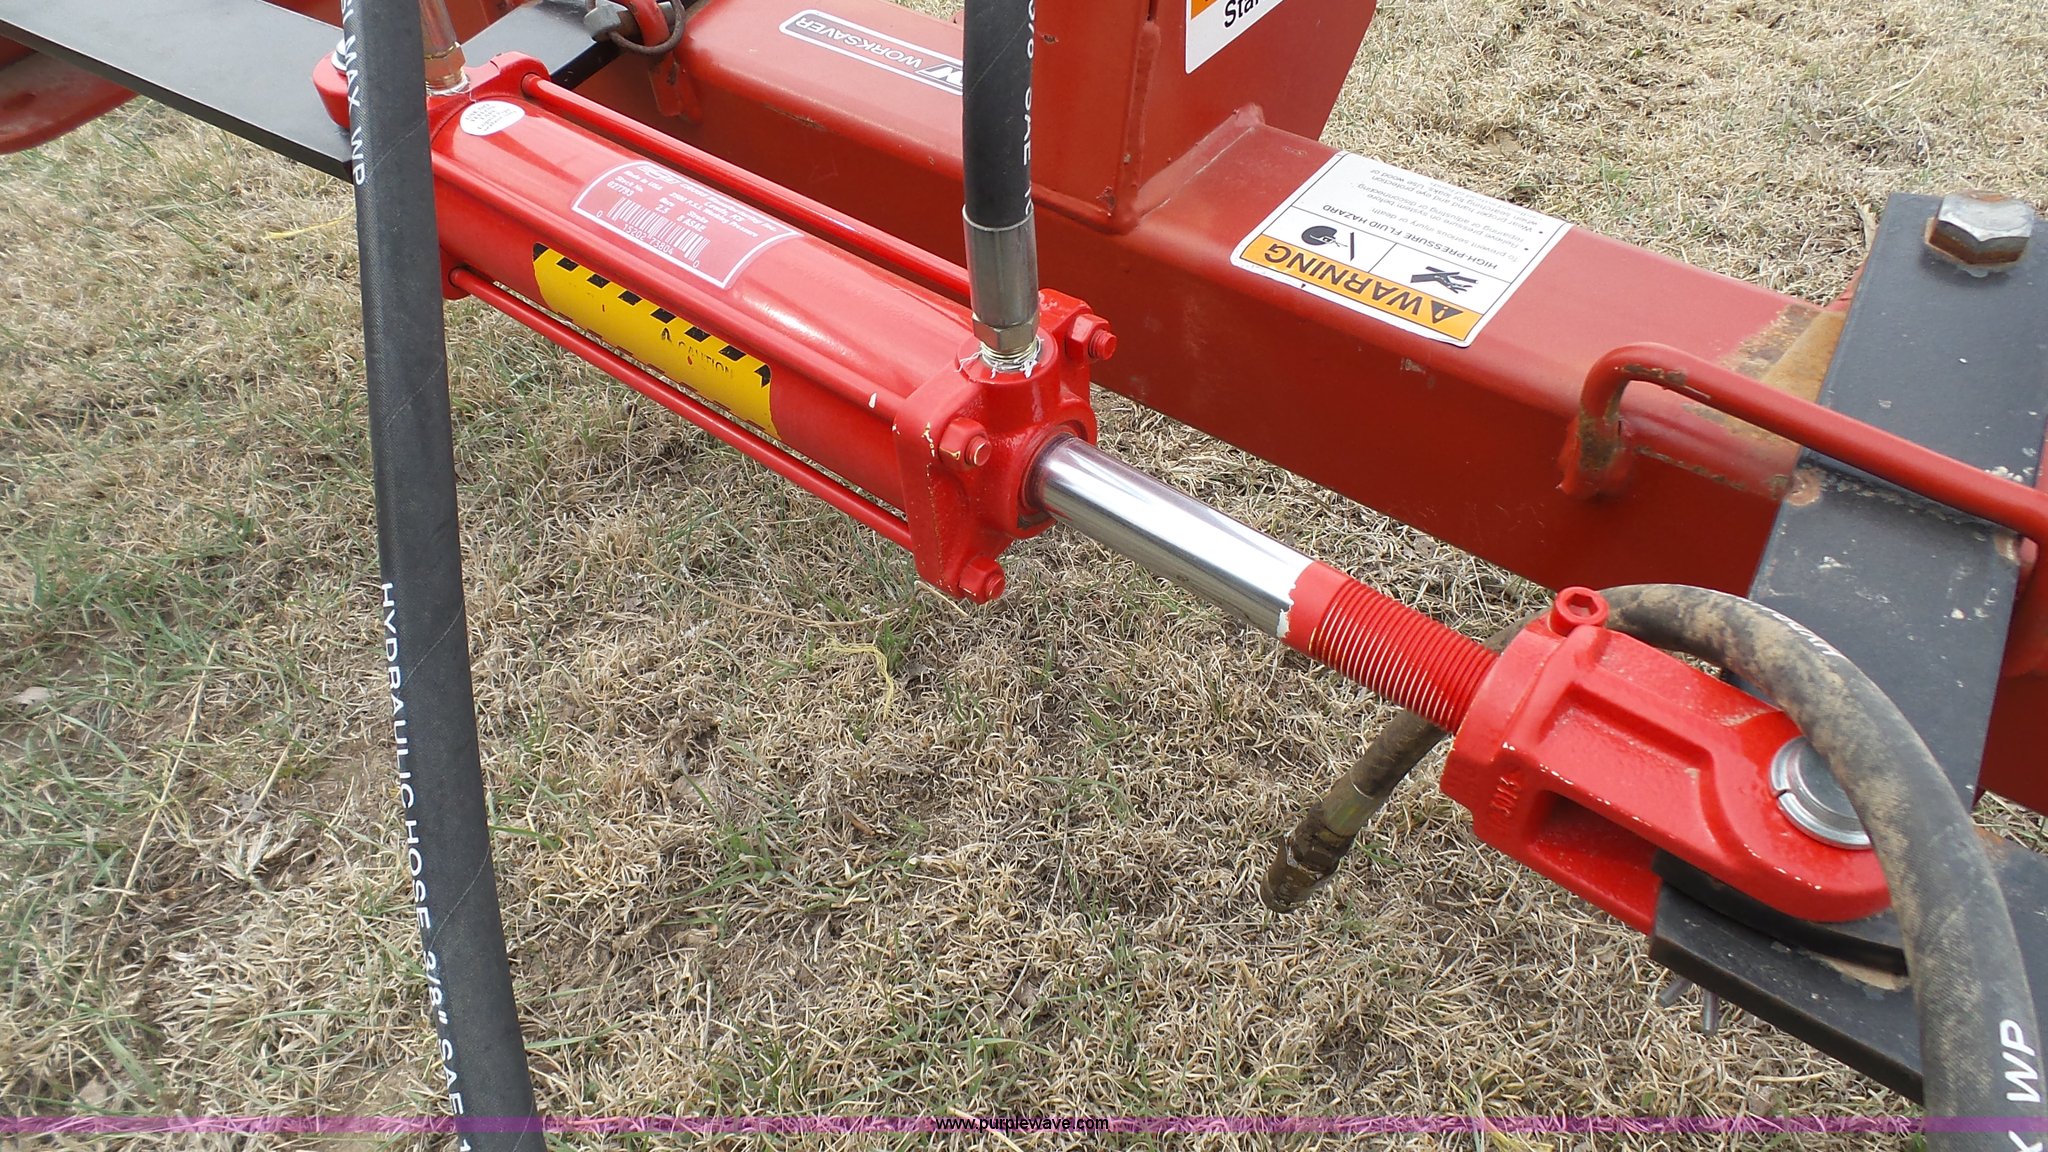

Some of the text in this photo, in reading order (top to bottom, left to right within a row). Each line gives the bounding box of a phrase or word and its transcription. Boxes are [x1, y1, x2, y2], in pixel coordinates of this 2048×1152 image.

[1224, 0, 1259, 28] Sta
[795, 16, 924, 69] WORKSAVER
[351, 126, 366, 186] WP
[614, 175, 634, 186] Stock
[1371, 175, 1414, 191] protection
[1380, 172, 1404, 181] wood
[647, 181, 662, 190] USA
[1406, 180, 1424, 189] Use
[1366, 193, 1394, 206] before
[1432, 195, 1450, 203] and
[654, 204, 670, 213] 2.5
[1396, 203, 1427, 216] system
[1451, 201, 1474, 212] hand
[1429, 206, 1469, 223] adjusting
[1476, 210, 1507, 222] proper
[682, 218, 705, 231] ASAE
[1409, 220, 1434, 231] injury
[1443, 219, 1483, 235] pressure
[1508, 221, 1532, 232] Wear
[595, 209, 699, 268] 0 15202 73804 0
[1322, 204, 1497, 268] HIGH-PRESSURE FLUID HAZARD
[1436, 229, 1469, 243] serious
[1470, 242, 1506, 256] prevent
[1507, 254, 1518, 262] To
[1265, 244, 1421, 314] WARNING
[381, 582, 415, 809] HYDRAULIC
[405, 819, 431, 929] HOSE
[439, 1038, 464, 1115] SAE
[1999, 1018, 2041, 1103] WP
